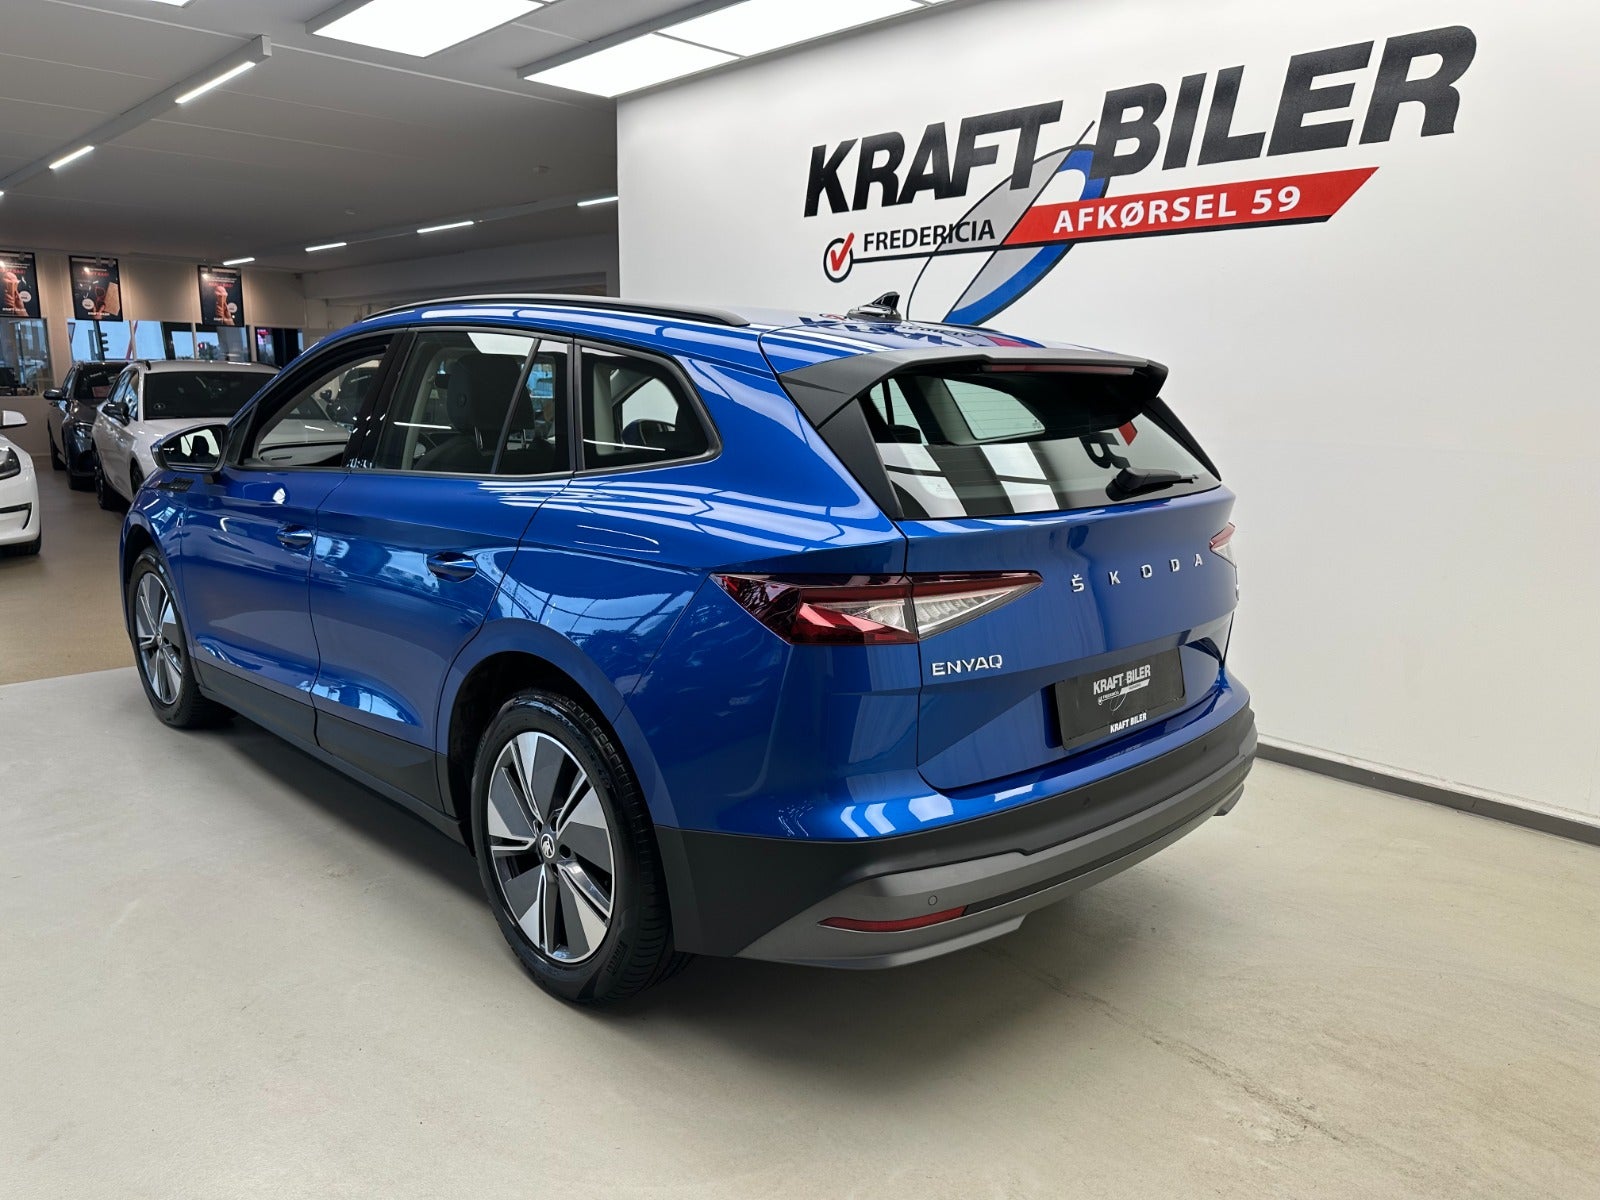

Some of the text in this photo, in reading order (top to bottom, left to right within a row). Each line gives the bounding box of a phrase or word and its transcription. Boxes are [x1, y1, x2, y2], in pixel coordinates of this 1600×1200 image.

[804, 25, 1477, 217] KRAFT BILER
[1053, 186, 1302, 234] AFKØRSEL 59
[863, 219, 996, 252] FREDERICIA
[931, 653, 1004, 677] ENYAQ
[1093, 673, 1124, 695] KRAFT
[1126, 664, 1151, 684] BILER
[1110, 712, 1147, 733] KRAFT BILER
